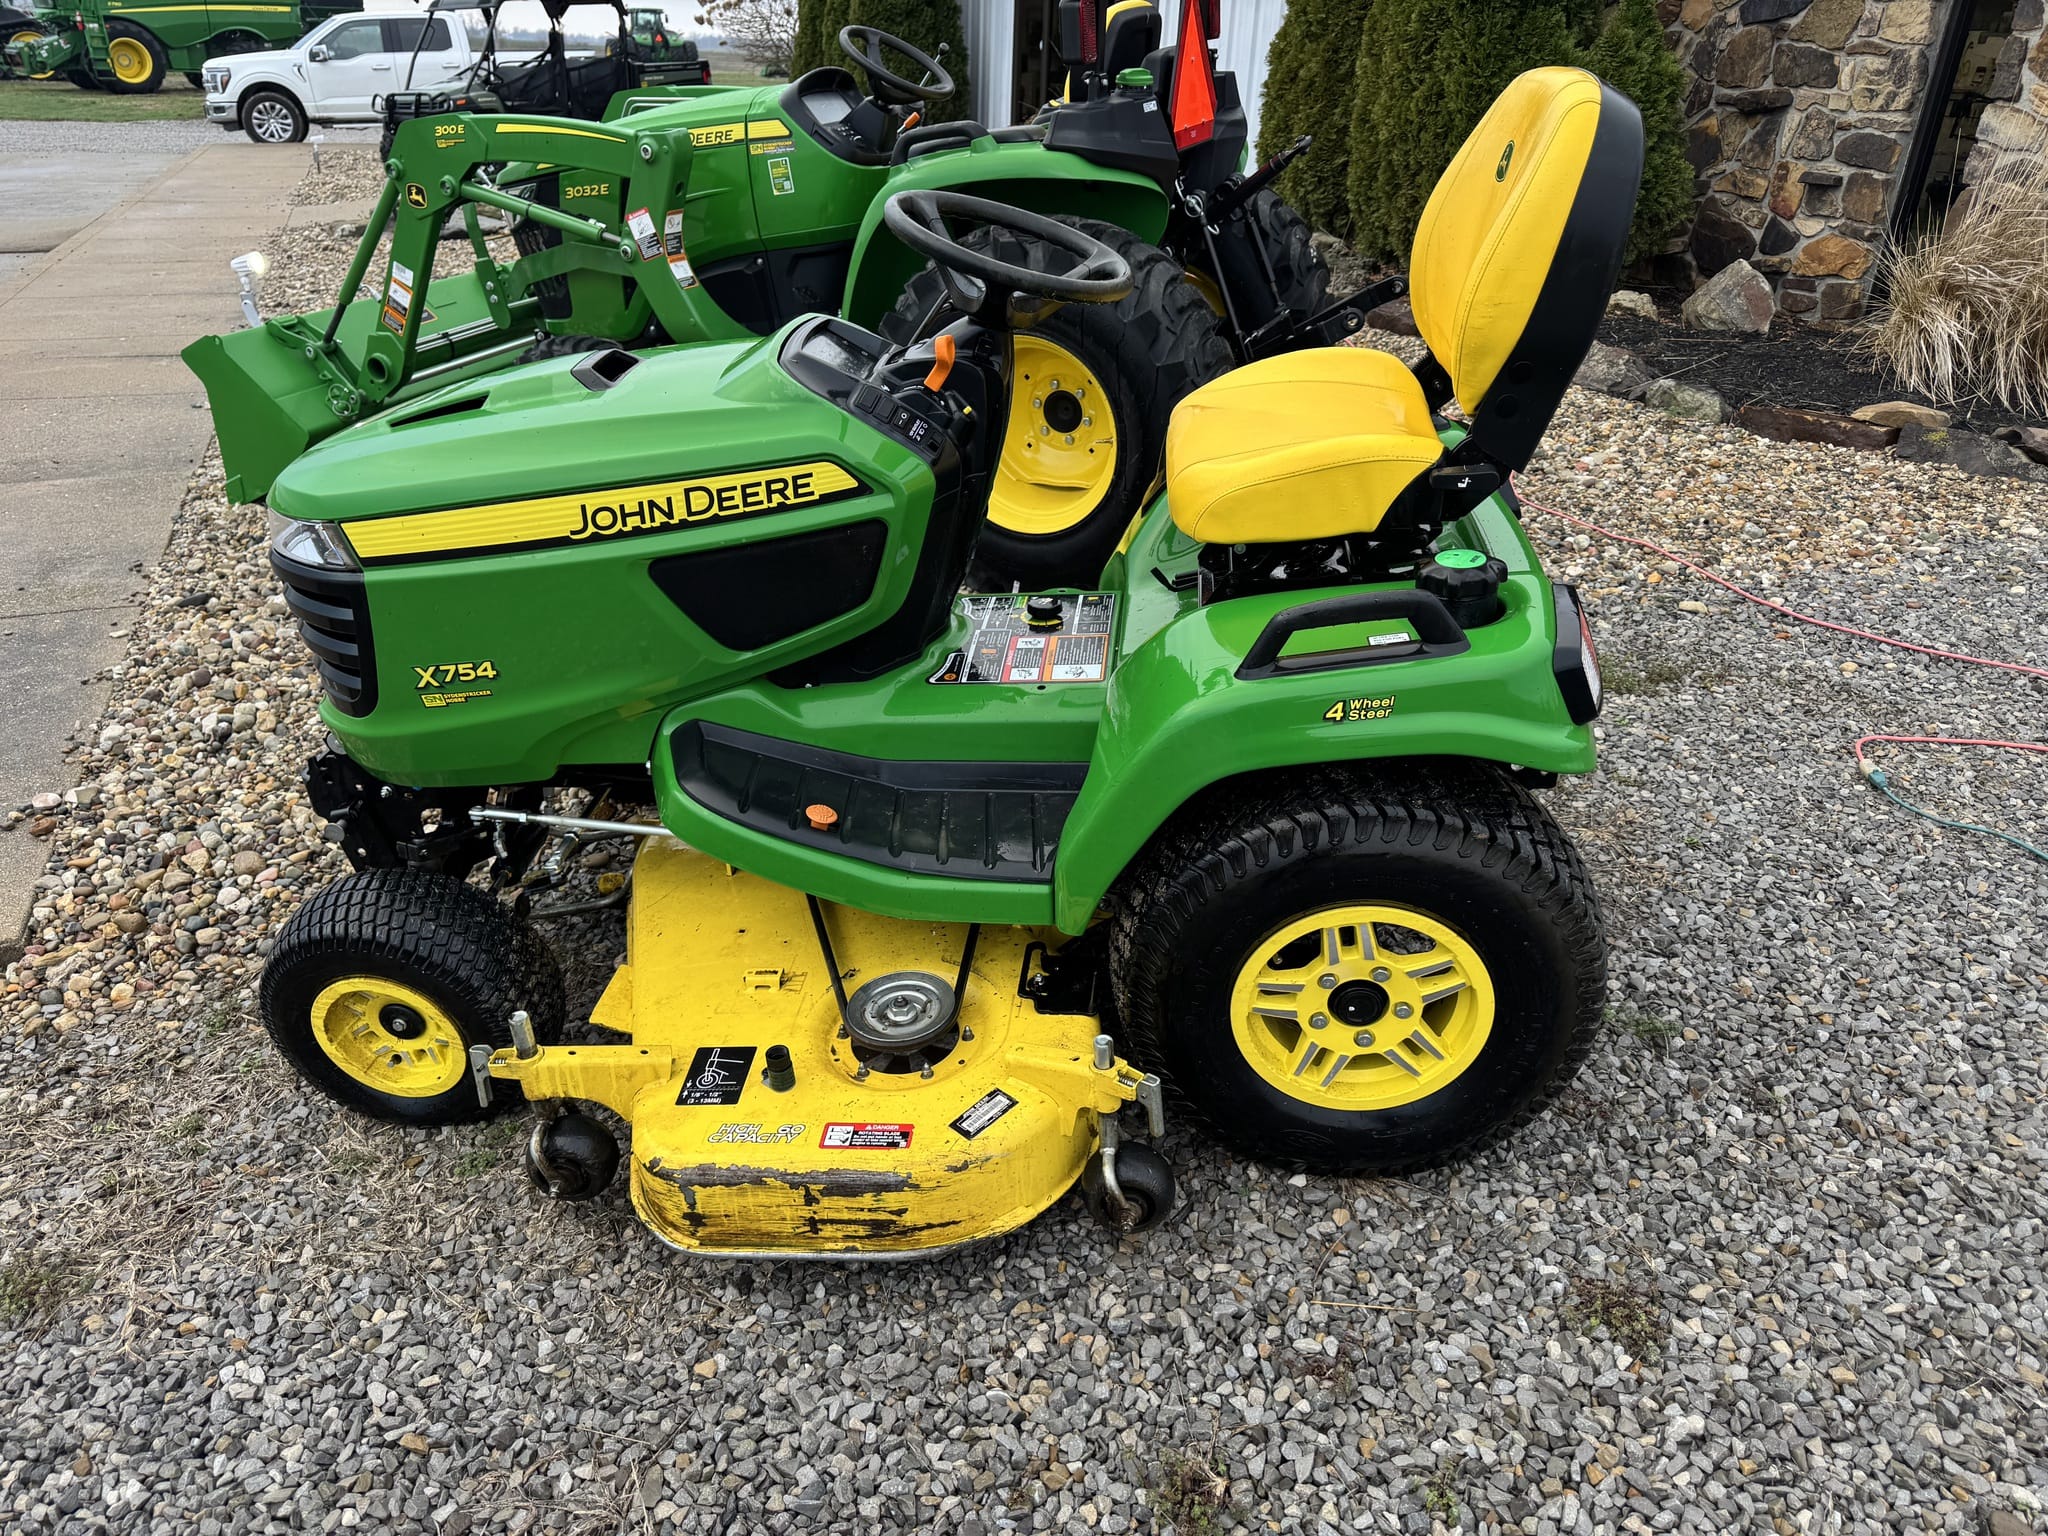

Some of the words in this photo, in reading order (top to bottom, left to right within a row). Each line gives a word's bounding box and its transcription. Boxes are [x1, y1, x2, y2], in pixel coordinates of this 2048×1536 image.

[565, 183, 609, 199] 3032E
[569, 496, 674, 536] JOHN
[684, 472, 815, 517] DEERE
[413, 661, 497, 688] X754
[1325, 701, 1344, 721] 4
[1350, 695, 1395, 710] Wheel
[1348, 708, 1392, 721] Steer
[717, 1123, 762, 1134] HIGH
[777, 1124, 806, 1134] 60
[708, 1133, 801, 1143] CAPACITY
